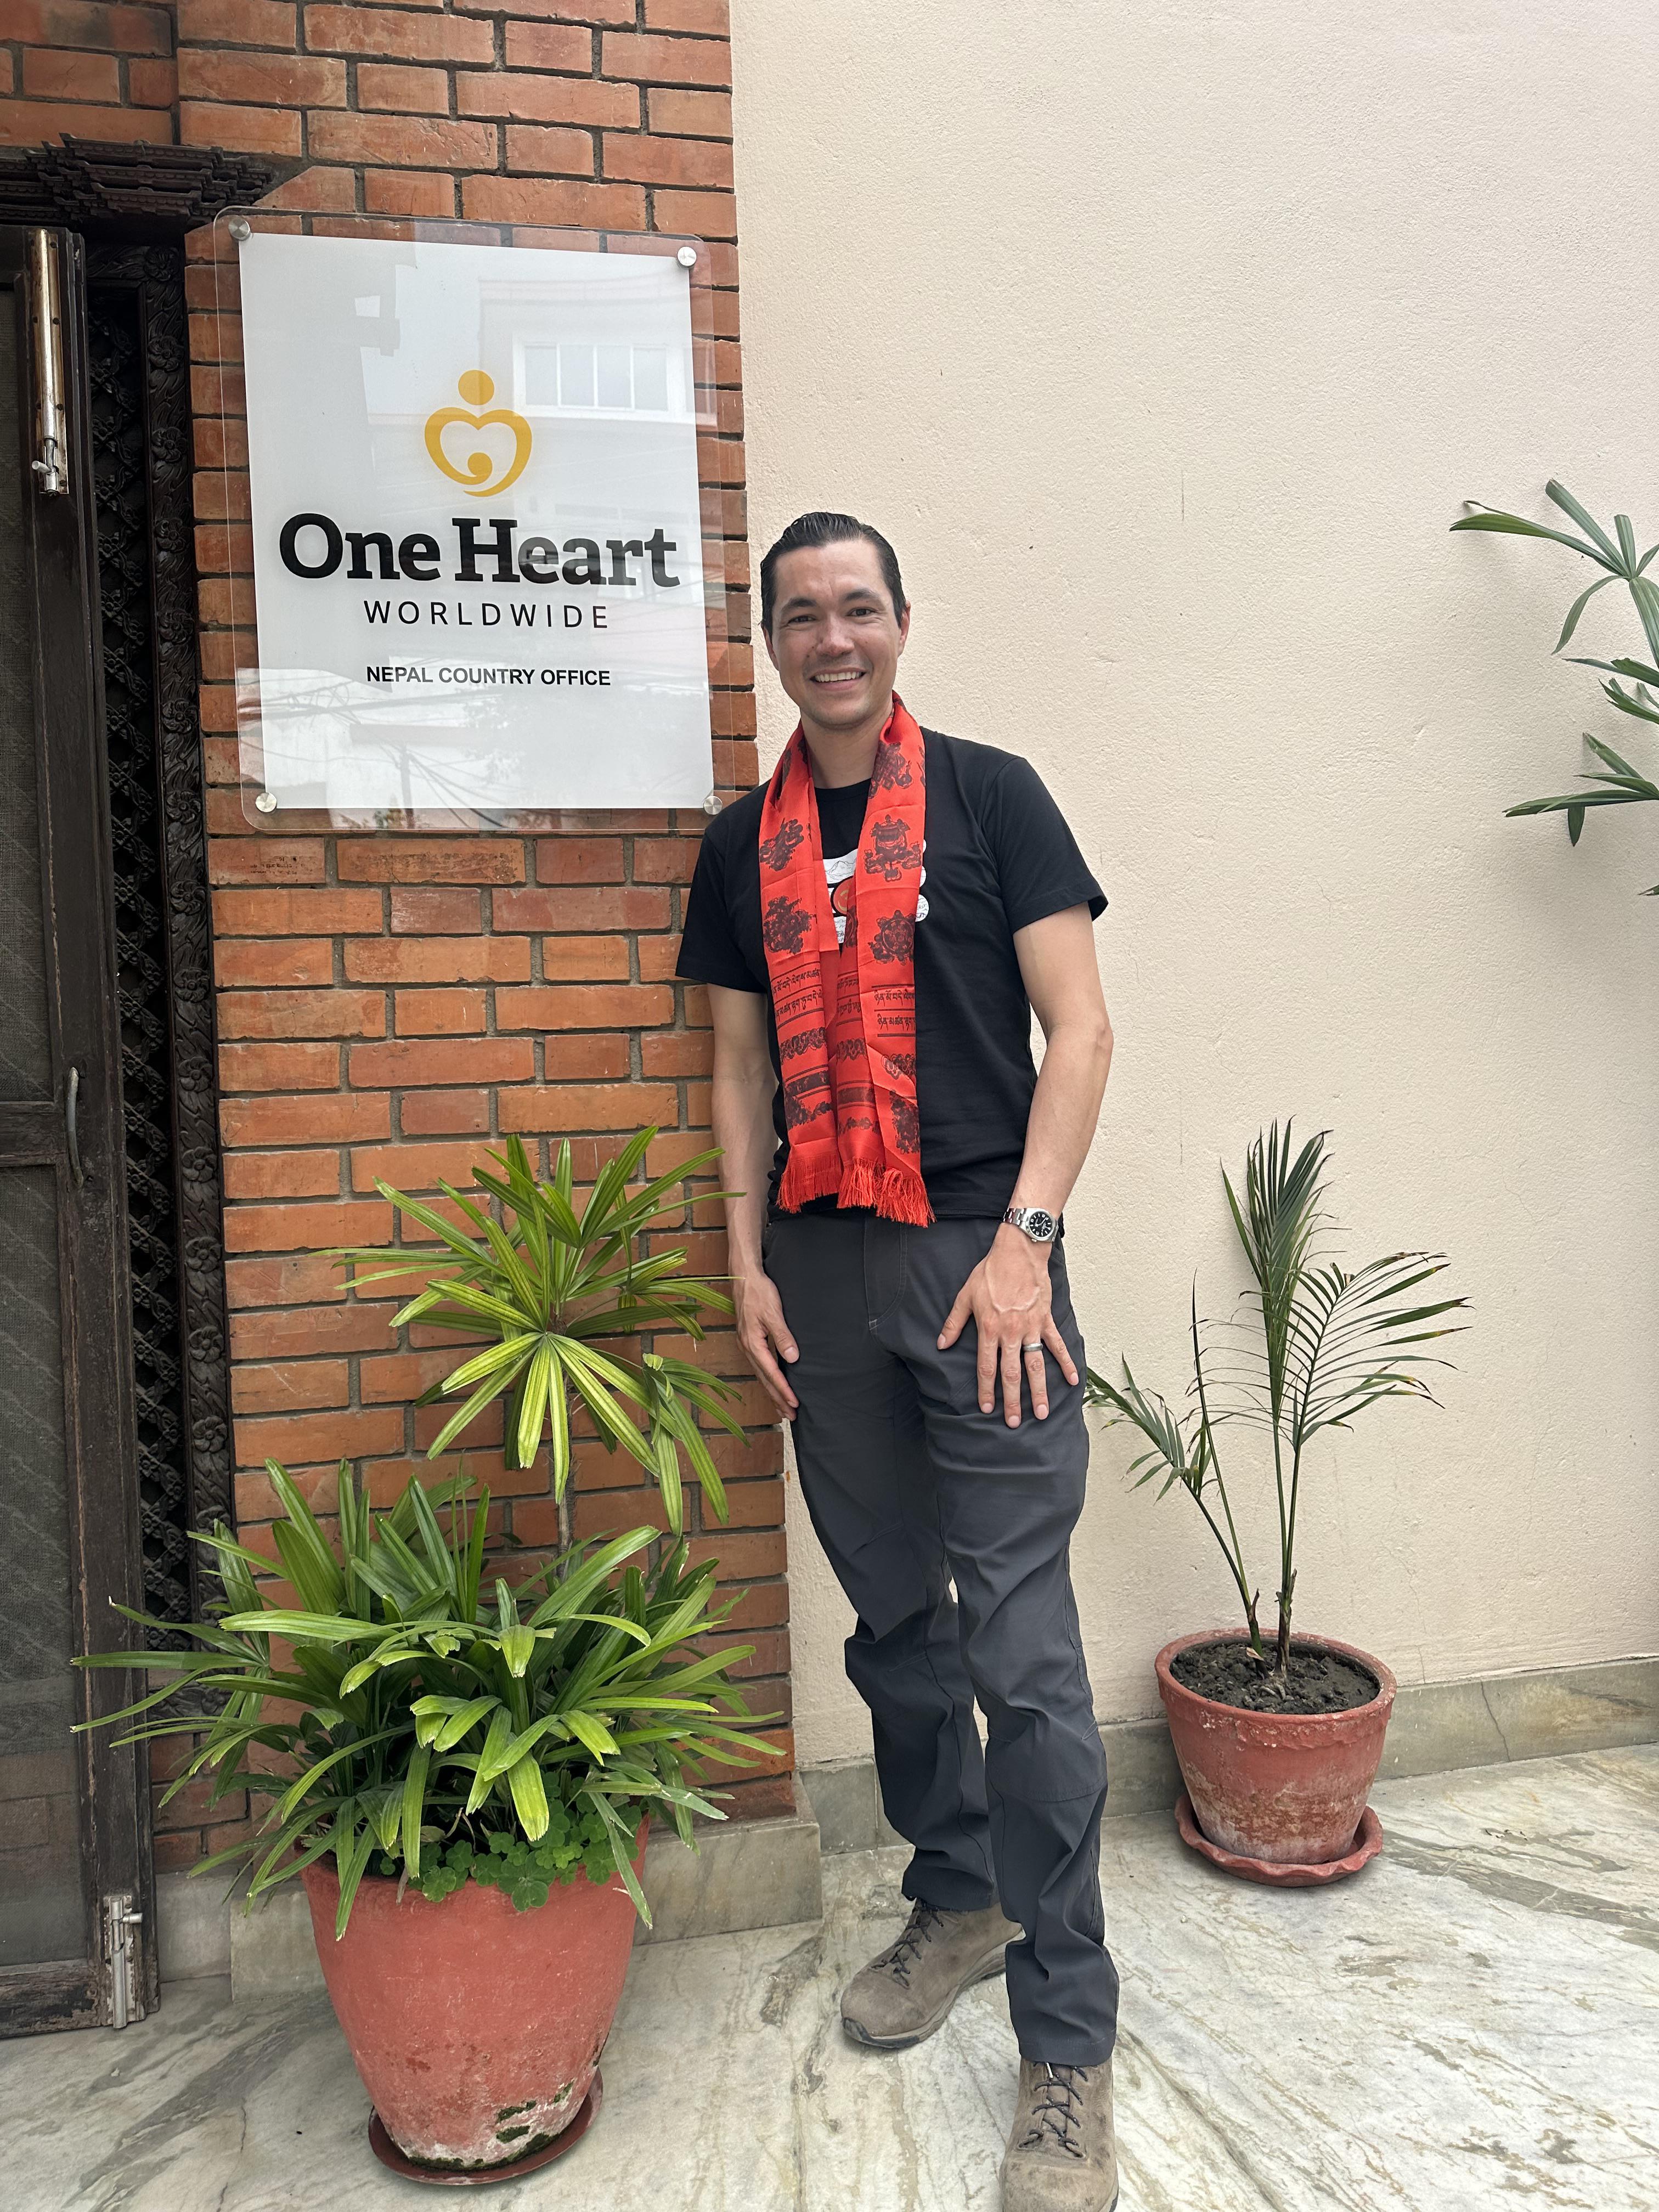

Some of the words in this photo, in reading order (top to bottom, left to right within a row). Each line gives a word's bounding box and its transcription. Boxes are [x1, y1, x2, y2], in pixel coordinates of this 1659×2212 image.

[279, 513, 441, 581] One
[452, 517, 680, 588] Heart
[363, 600, 607, 629] WORLDWIDE
[366, 666, 433, 682] NEPAL
[439, 668, 535, 685] COUNTRY
[540, 669, 611, 686] OFFICE
